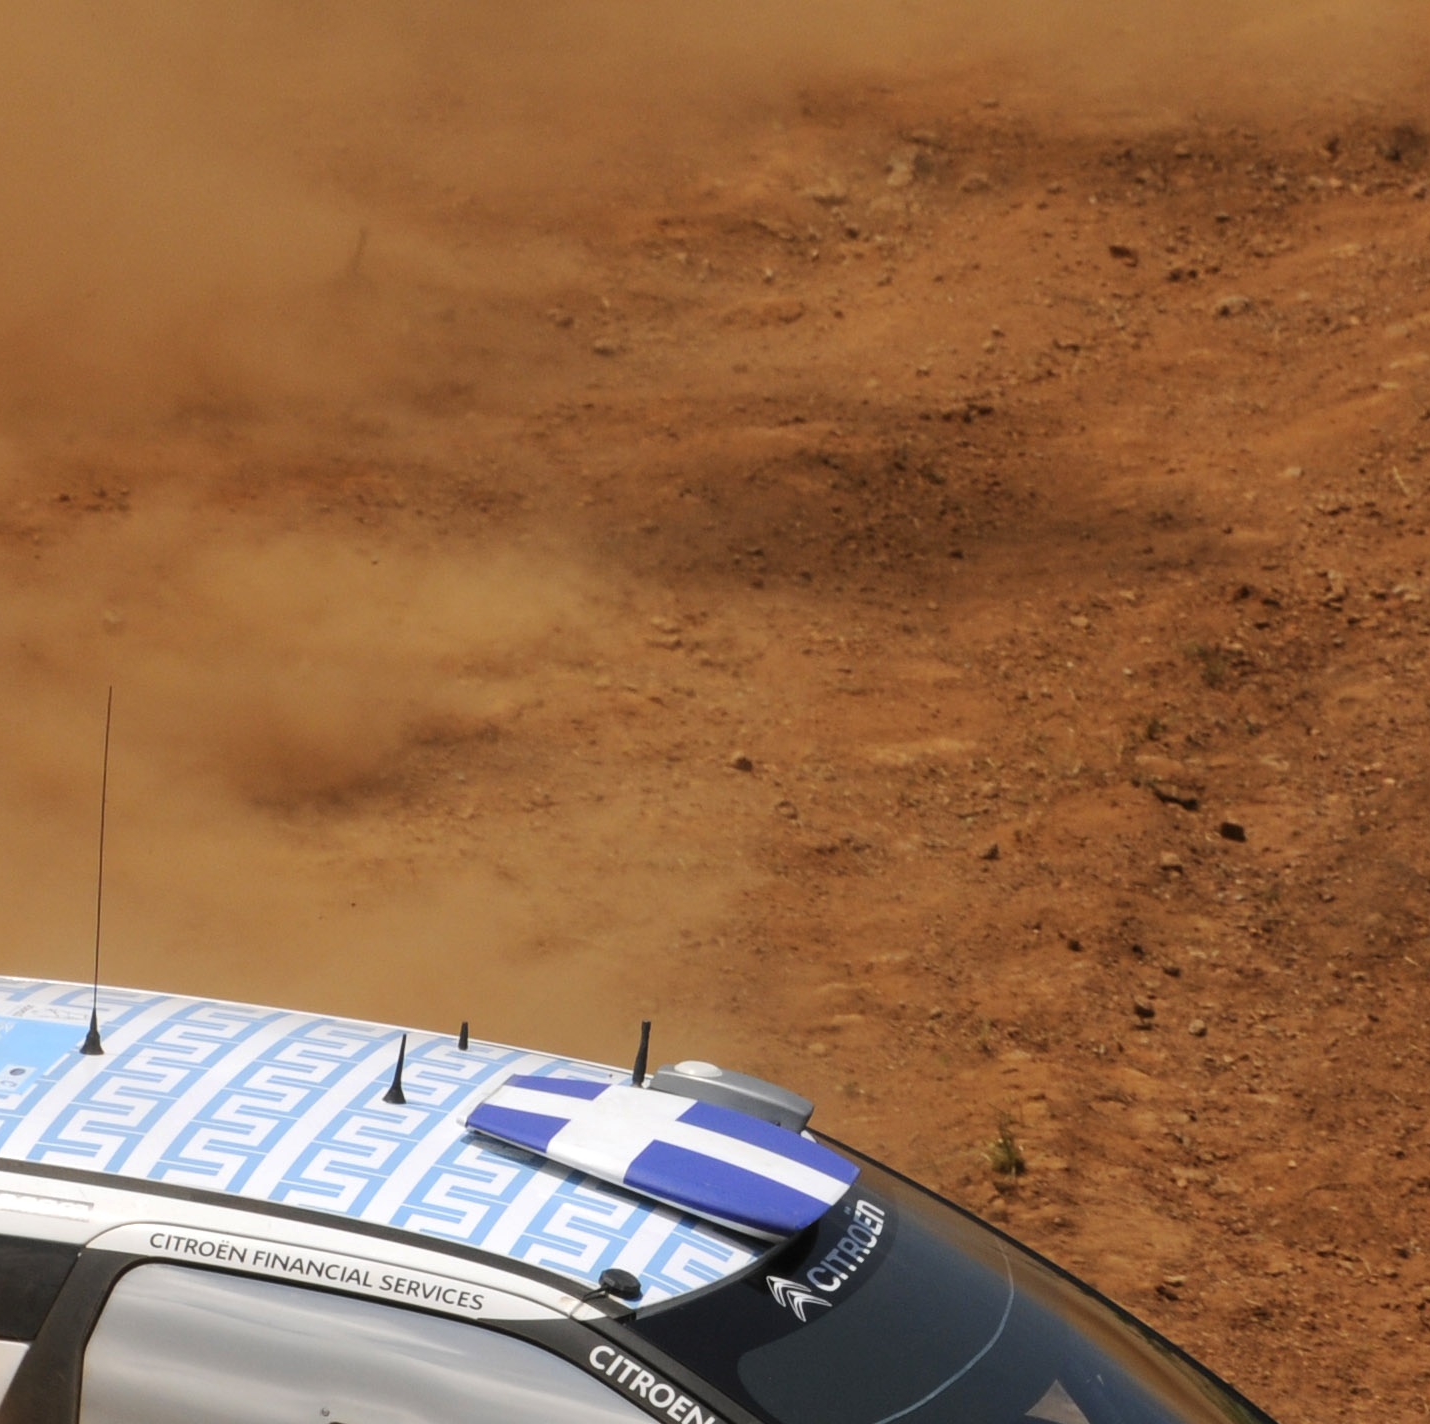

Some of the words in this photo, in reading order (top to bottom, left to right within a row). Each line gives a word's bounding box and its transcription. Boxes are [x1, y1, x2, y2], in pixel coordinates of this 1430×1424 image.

[149, 1232, 248, 1263] CITROËN
[252, 1251, 373, 1289] FINANCIAL
[378, 1275, 485, 1311] SERVICES
